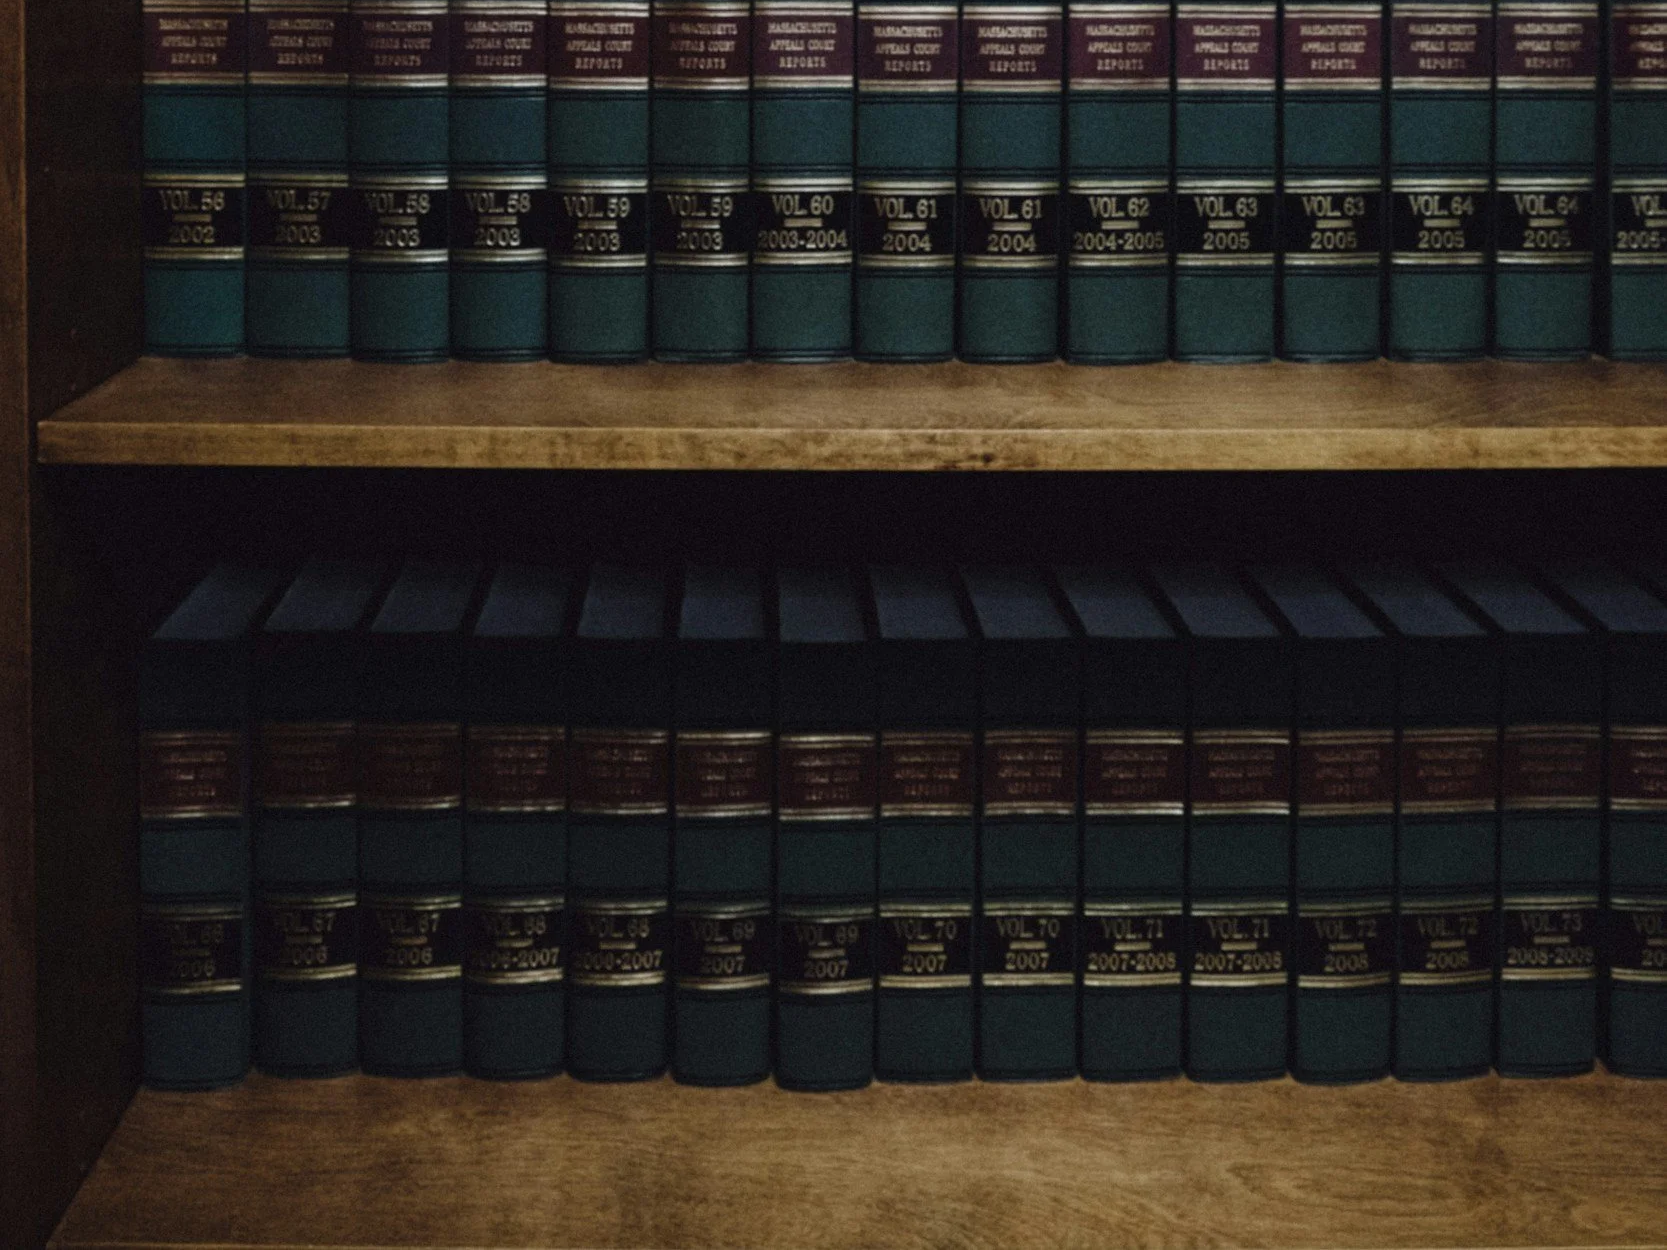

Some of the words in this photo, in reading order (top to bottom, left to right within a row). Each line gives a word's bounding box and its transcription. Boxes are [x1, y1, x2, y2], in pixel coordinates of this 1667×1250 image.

[770, 40, 805, 51] APPEALS
[808, 40, 835, 51] COURT
[1194, 42, 1230, 53] APPEALS
[1233, 42, 1259, 53] COURT
[779, 57, 826, 68] REPORTS
[1204, 59, 1249, 70] REPORTS
[169, 226, 215, 244] 2002
[276, 226, 321, 244] 2003
[374, 229, 420, 247] 2003
[475, 229, 520, 247] 2003
[574, 232, 620, 251] 2003
[677, 231, 723, 250] 2003
[759, 230, 847, 249] 2003-2004
[883, 234, 931, 252] 2004
[988, 234, 1036, 252] 2004
[1074, 232, 1164, 250] 2004-2005
[1203, 232, 1250, 250] 2005
[1311, 231, 1357, 249] 2005
[1419, 231, 1464, 249] 2005
